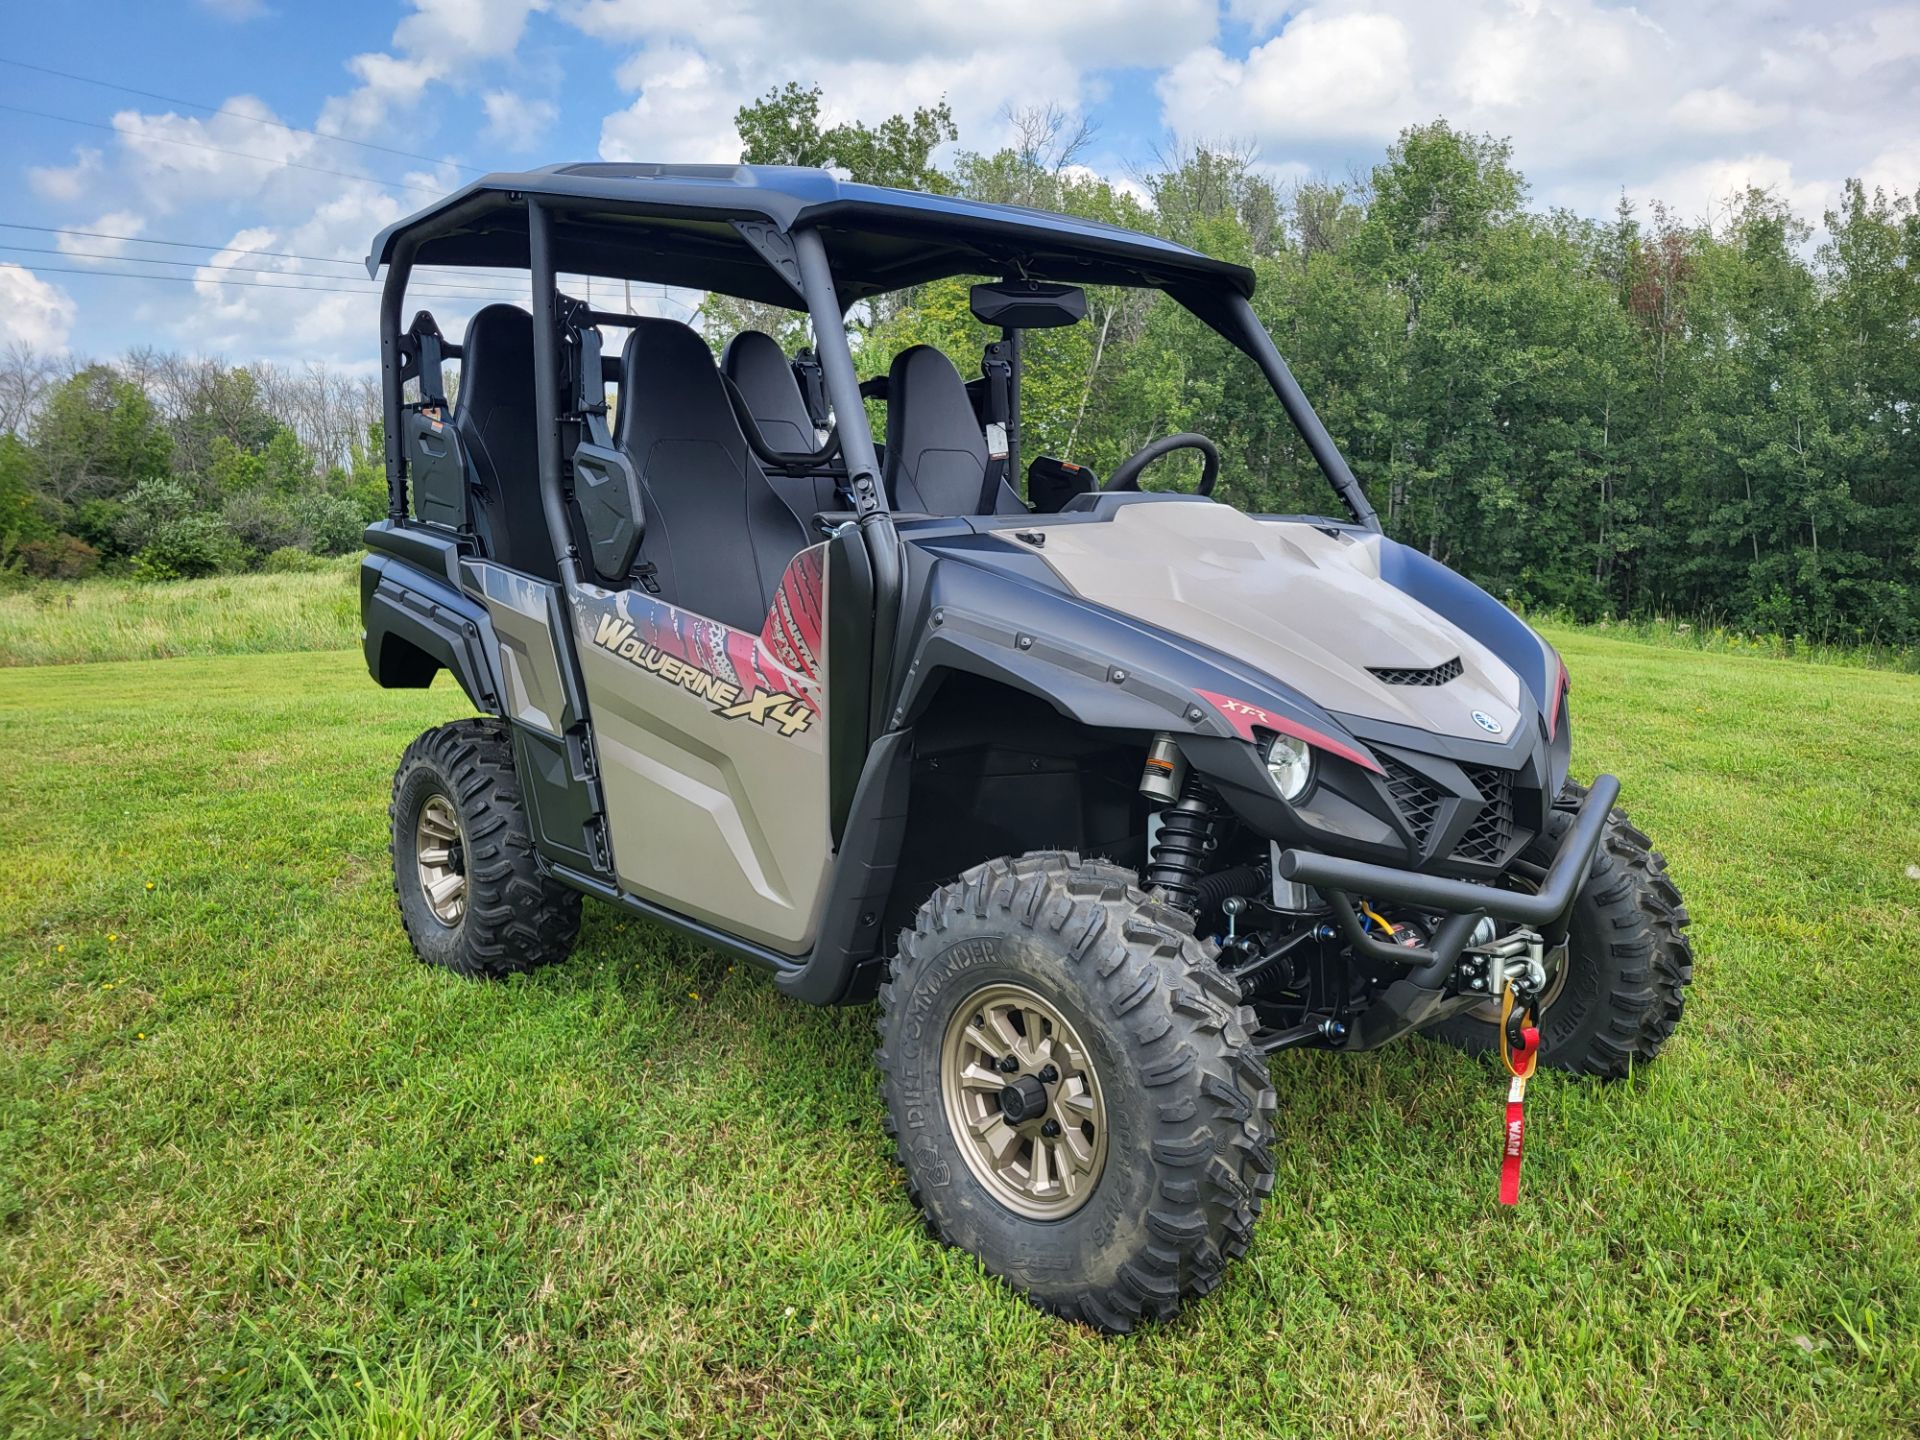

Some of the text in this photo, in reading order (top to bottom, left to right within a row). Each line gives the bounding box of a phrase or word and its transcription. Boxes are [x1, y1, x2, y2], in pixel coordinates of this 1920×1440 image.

[711, 685, 816, 738] X4
[903, 940, 999, 1061] COMMANDER
[1507, 1120, 1522, 1156] WARN
